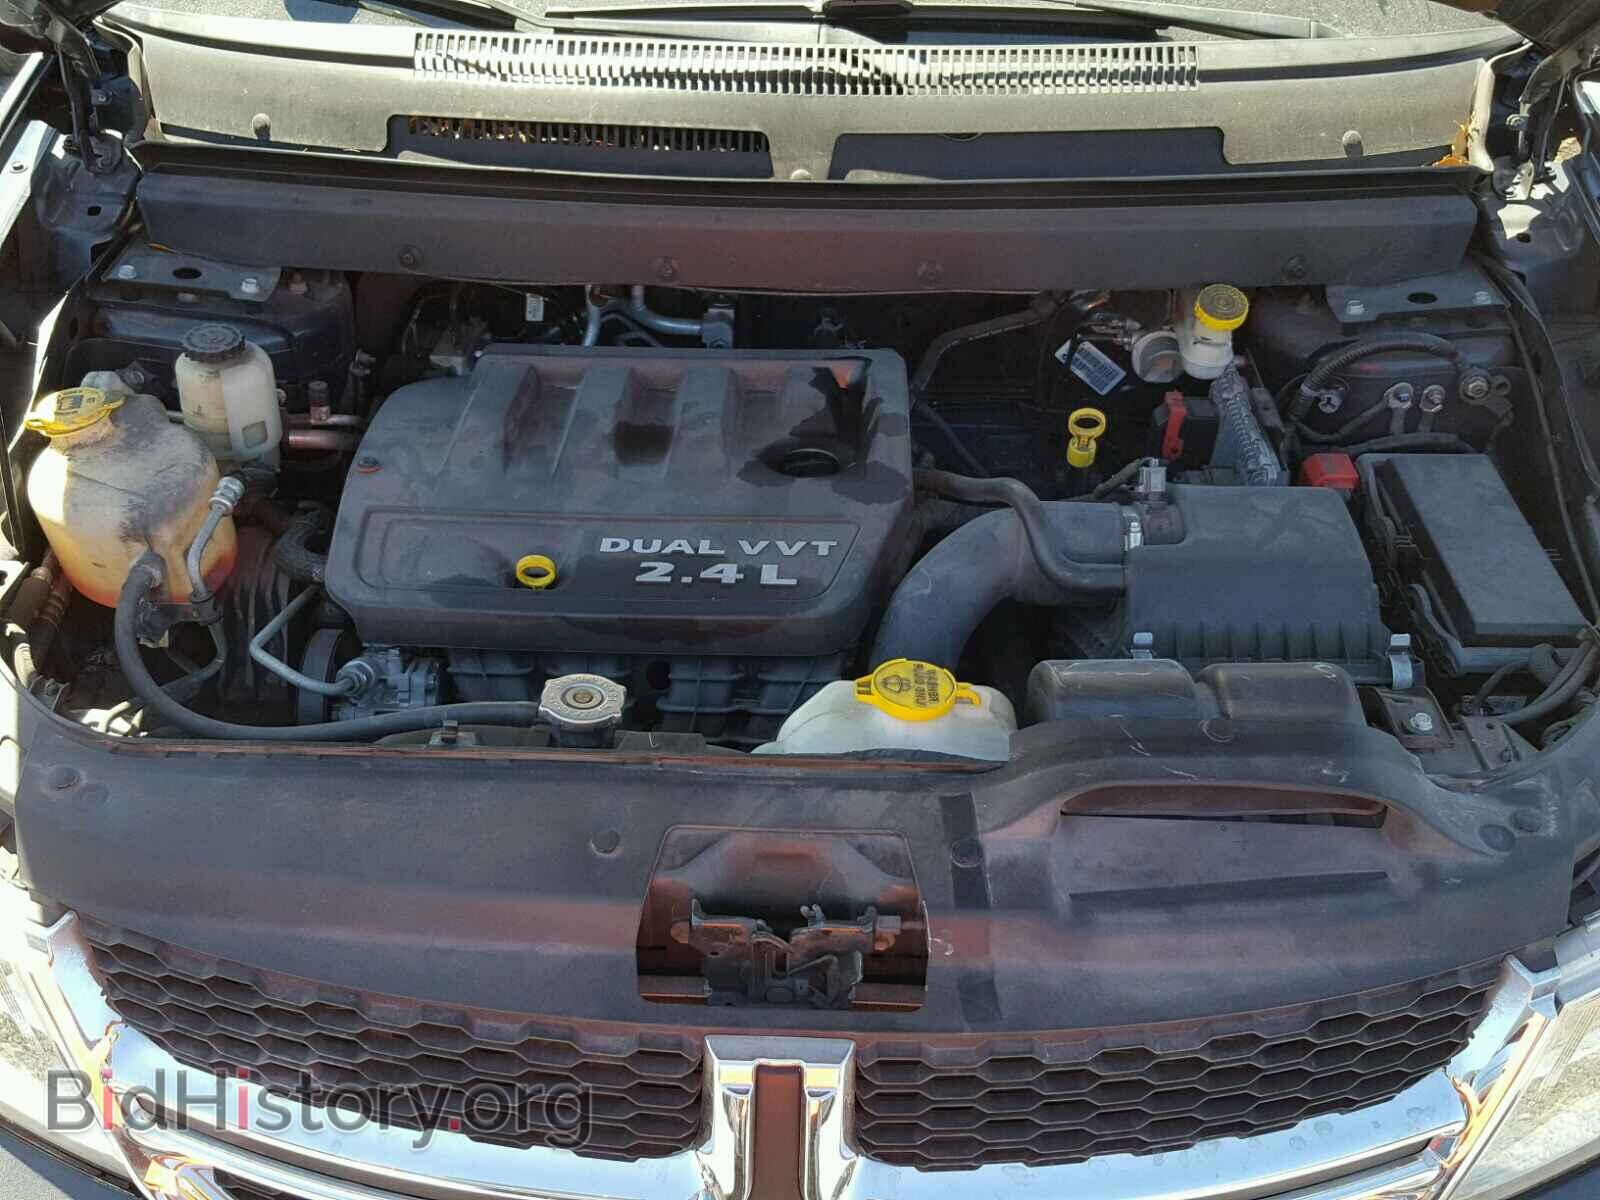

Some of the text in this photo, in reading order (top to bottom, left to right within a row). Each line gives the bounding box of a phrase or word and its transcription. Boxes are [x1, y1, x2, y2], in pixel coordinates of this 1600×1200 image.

[600, 538, 838, 556] DUAL VVT
[635, 562, 798, 585] 2.4 L
